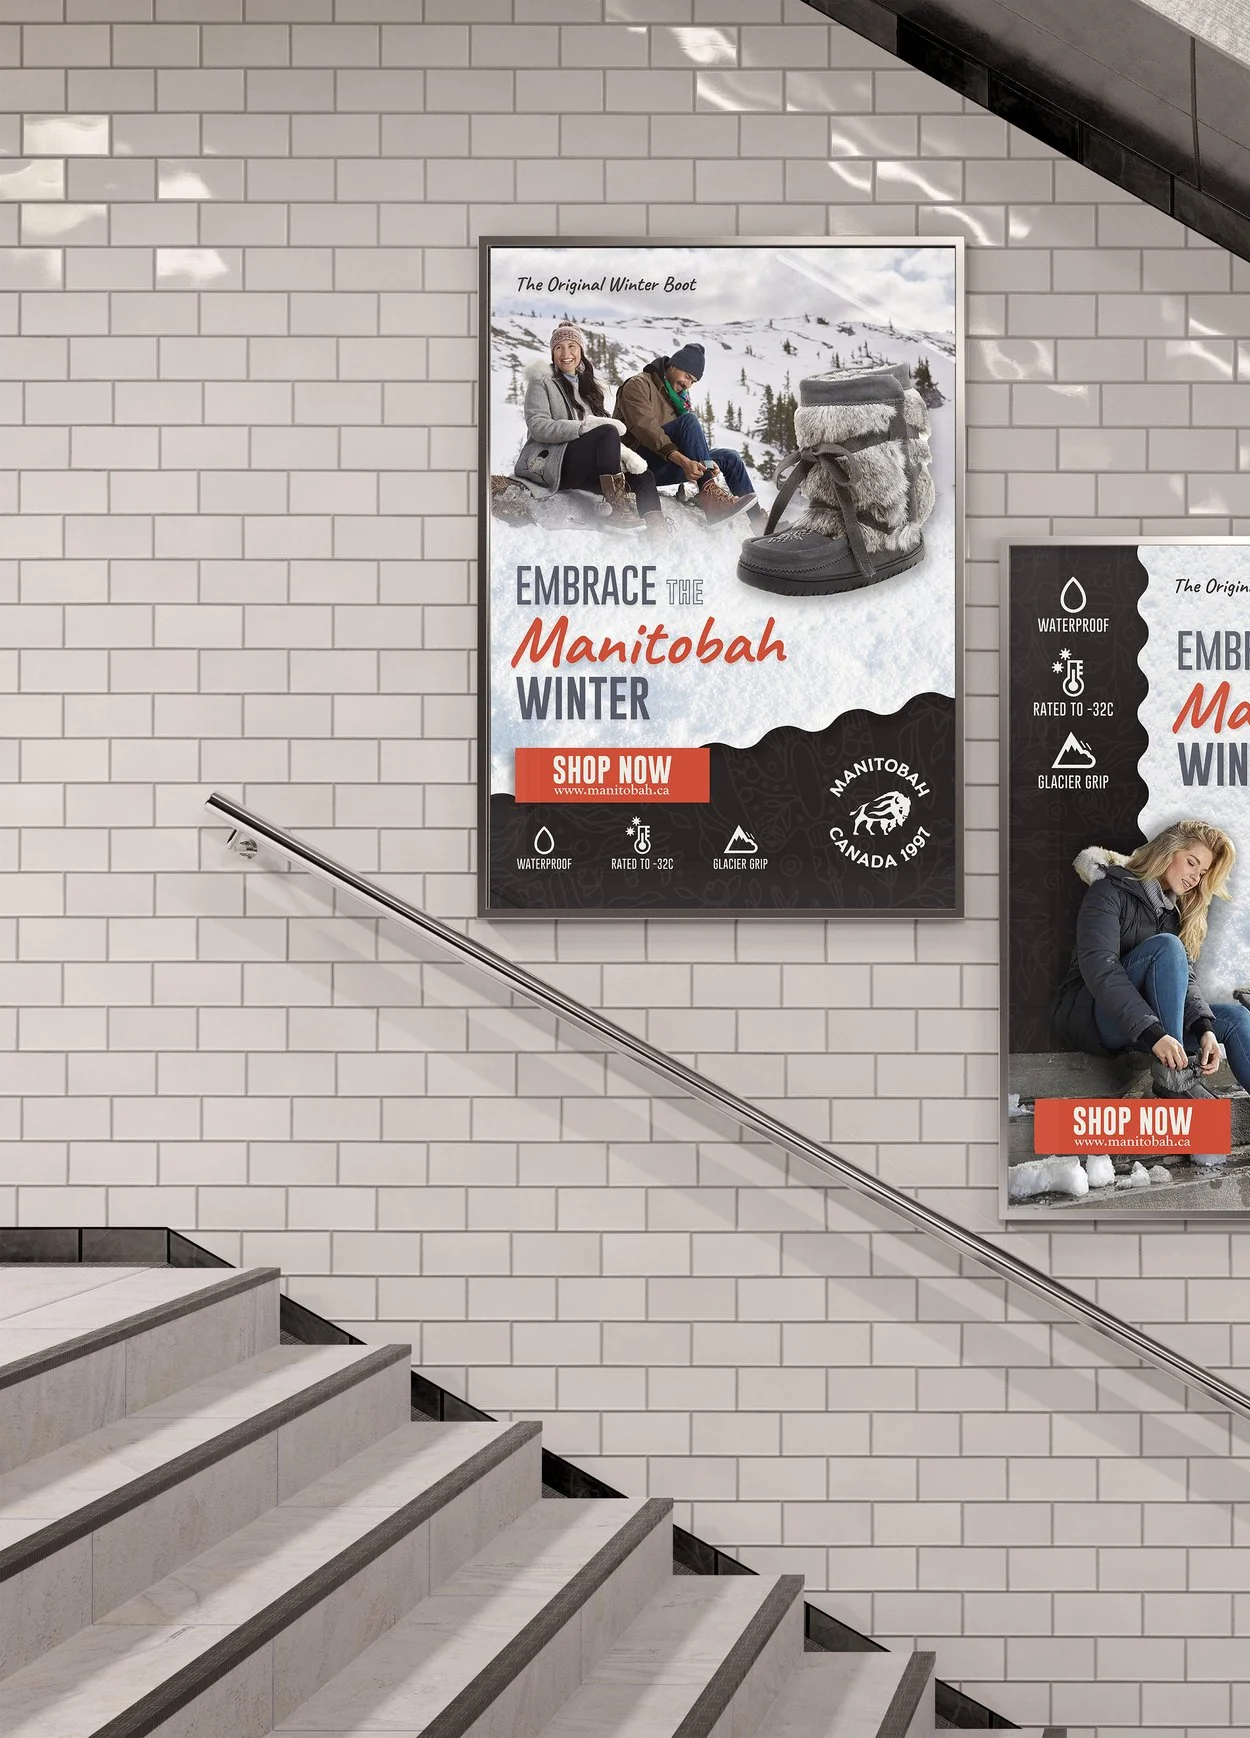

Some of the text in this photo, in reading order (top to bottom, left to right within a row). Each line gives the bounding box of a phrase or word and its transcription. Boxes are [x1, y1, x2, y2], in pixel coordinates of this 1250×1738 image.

[517, 277, 697, 295] The Original Winter Boot
[517, 565, 703, 605] EMBRACE THE
[1175, 579, 1201, 594] The
[1038, 618, 1109, 633] WATERPROOF
[511, 615, 787, 668] Manitobah
[516, 676, 650, 720] WINTER
[1033, 702, 1113, 716] RATED TO -32C
[553, 756, 672, 784] SHOP NOW
[829, 758, 930, 797] MANITOBAH
[1038, 775, 1109, 789] GLACIER GRIP
[554, 783, 669, 797] www.manitobah.ca
[829, 826, 931, 869] CANADA 1997
[517, 858, 572, 869] WATERPROOF
[611, 858, 674, 870] RATED TO -32C
[713, 858, 768, 869] GLACIER GRIP
[1073, 1107, 1193, 1135] SHOP NOW
[1074, 1135, 1191, 1148] www.manitobah.ca
